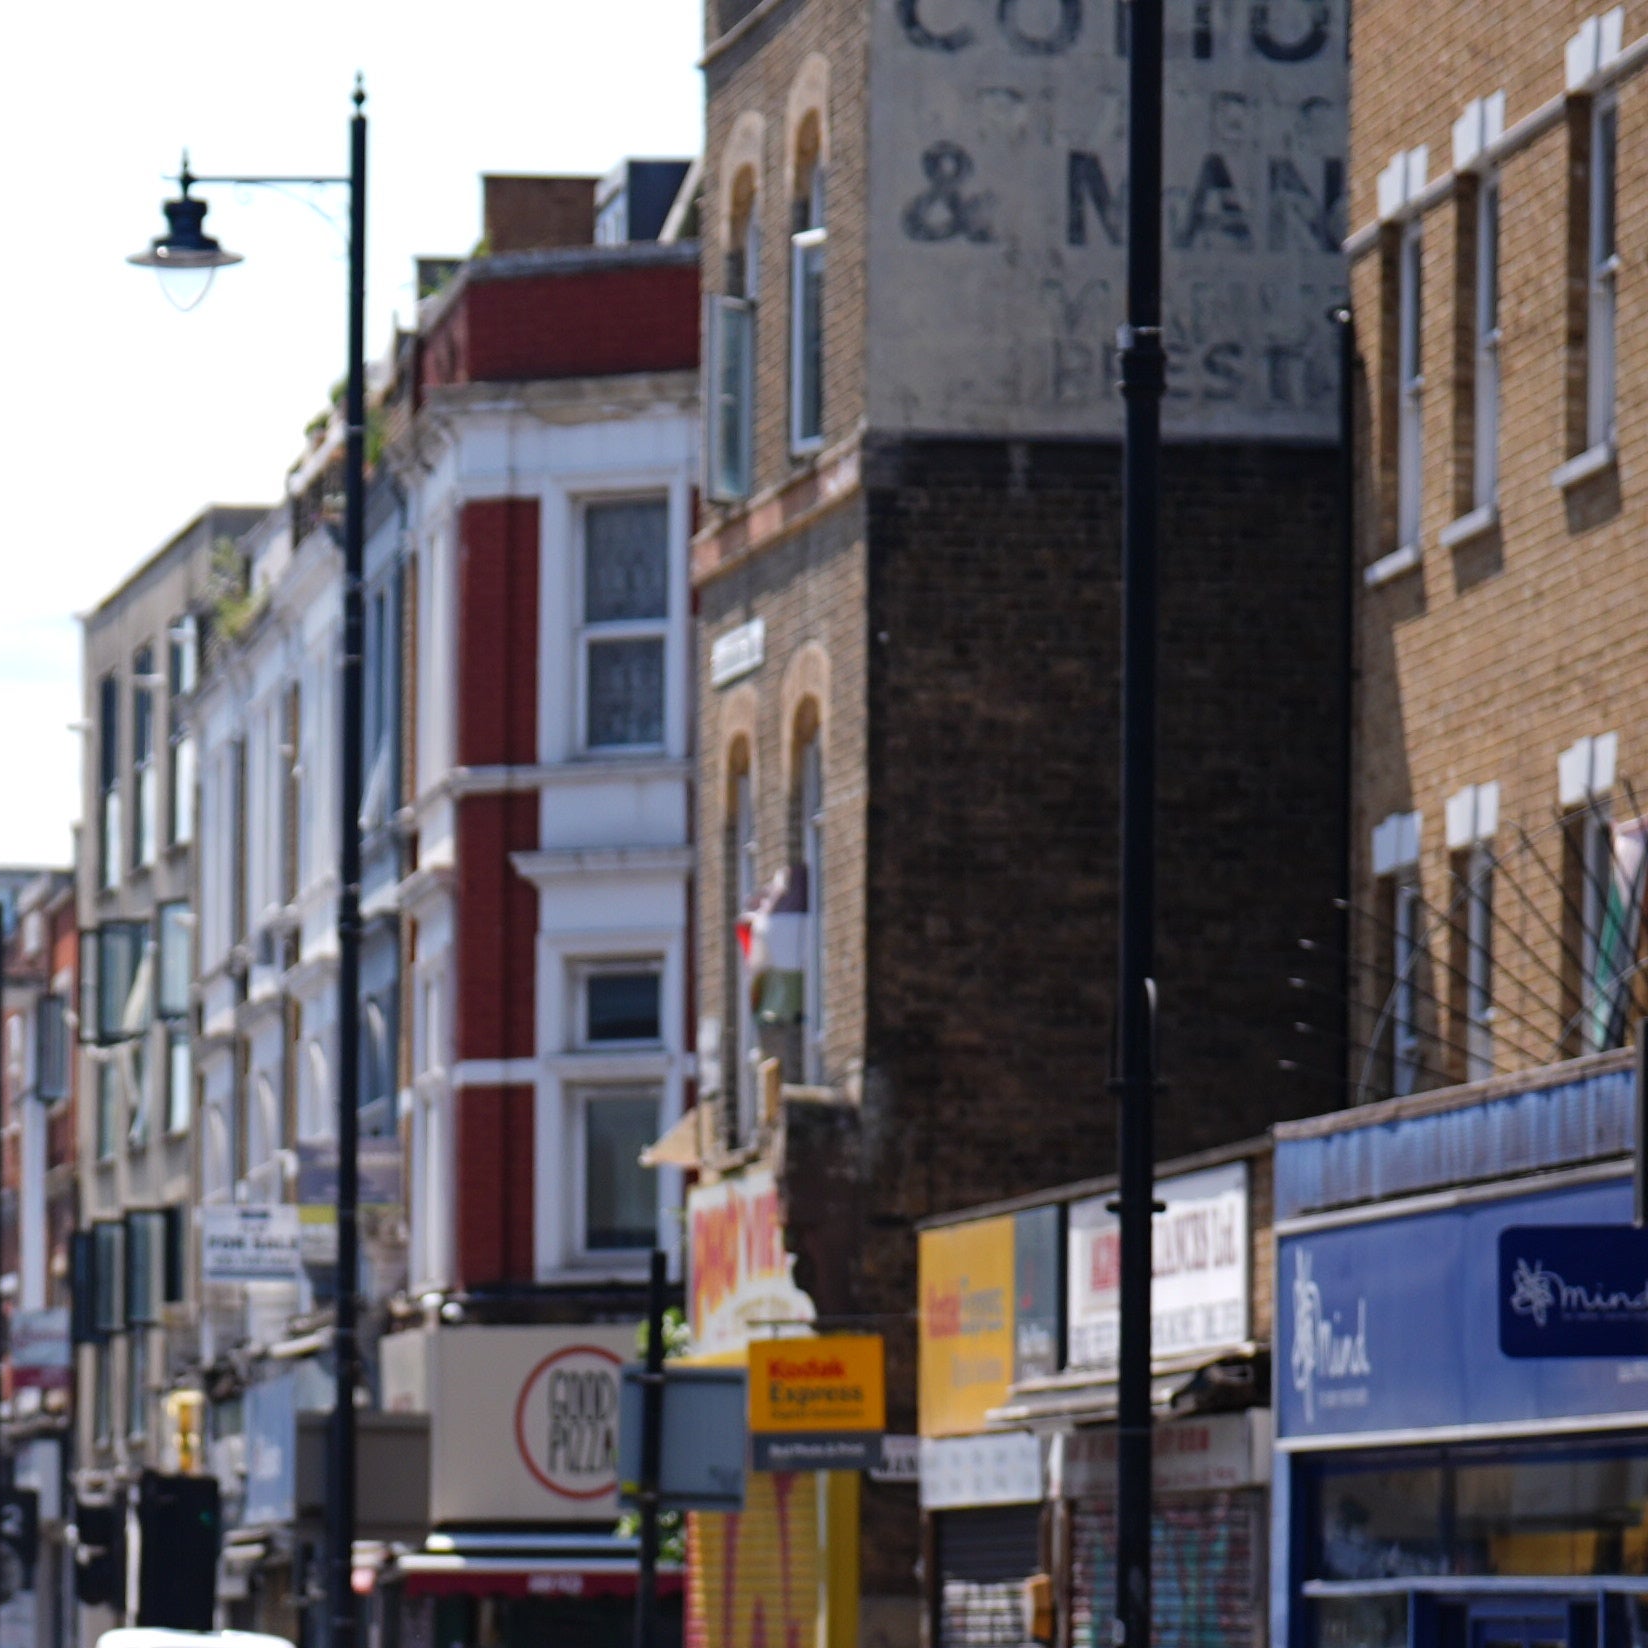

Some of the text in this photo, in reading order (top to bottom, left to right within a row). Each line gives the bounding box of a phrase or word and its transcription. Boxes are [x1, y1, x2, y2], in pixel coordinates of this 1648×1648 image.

[767, 1356, 845, 1380] Kodak
[548, 1368, 617, 1420] GOOD
[768, 1381, 864, 1406] Express
